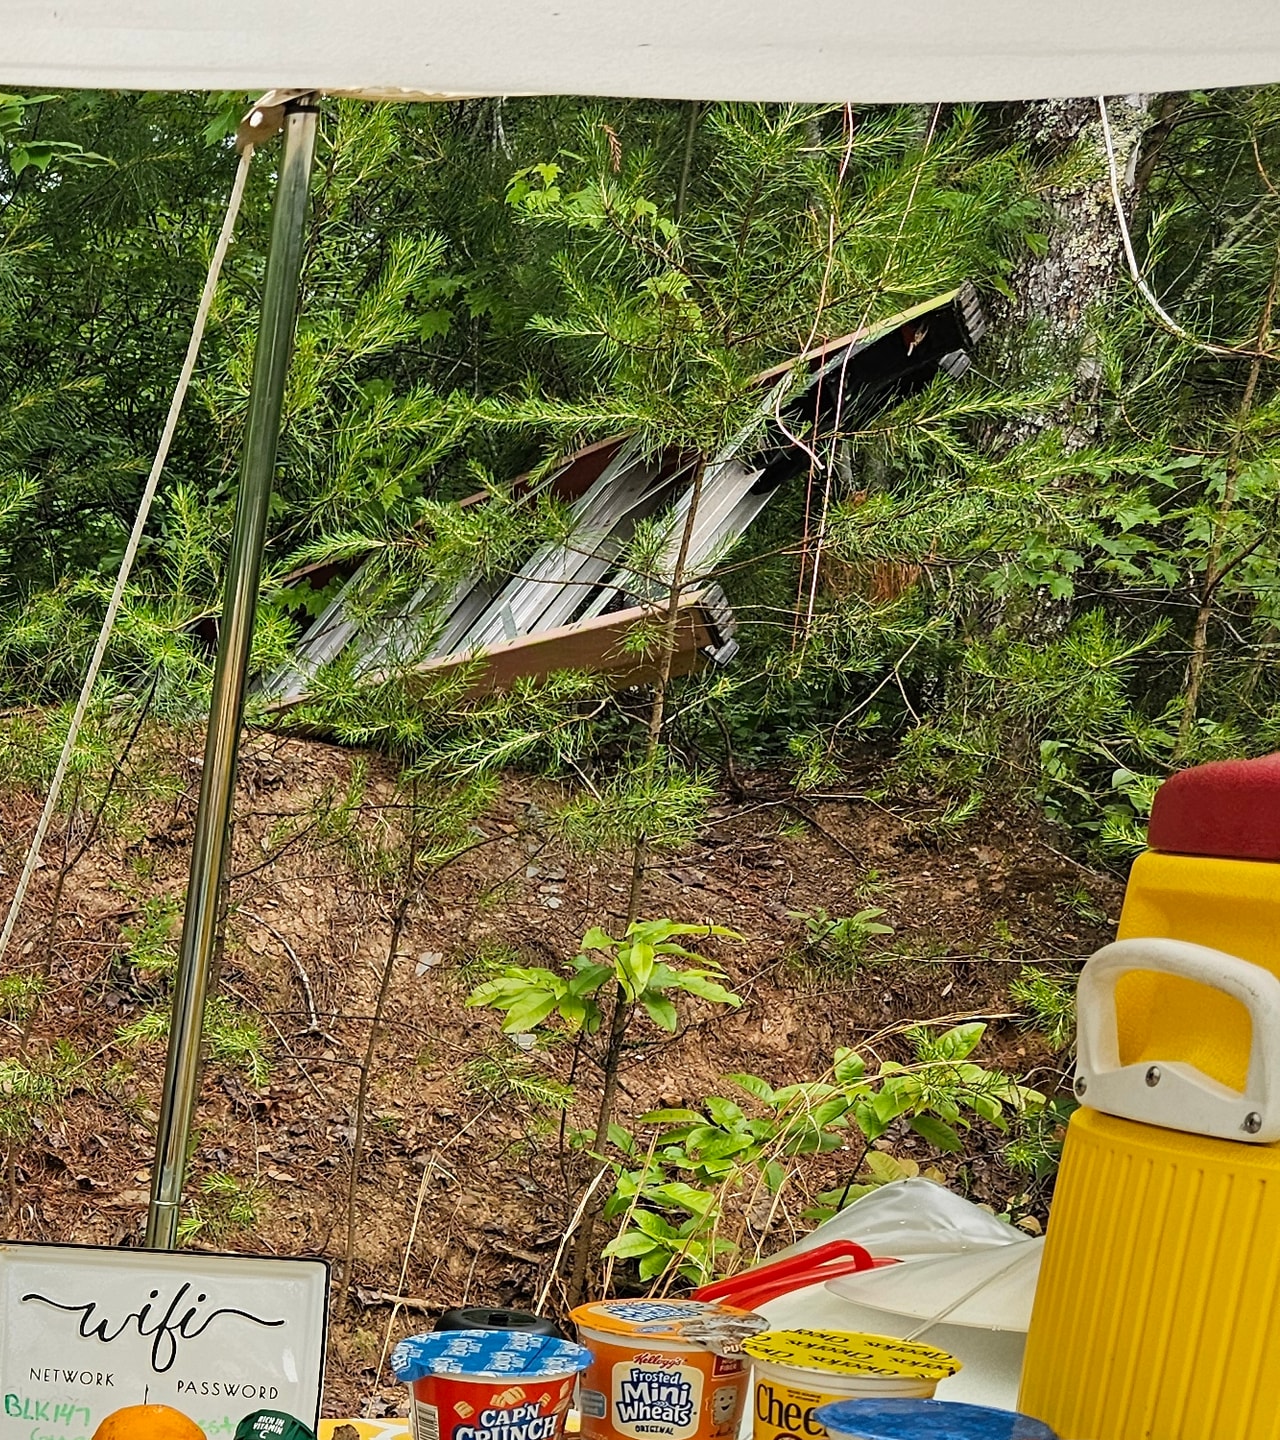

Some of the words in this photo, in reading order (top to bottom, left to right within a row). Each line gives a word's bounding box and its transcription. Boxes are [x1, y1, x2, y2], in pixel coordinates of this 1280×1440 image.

[22, 1282, 285, 1373] wifi
[633, 1352, 683, 1369] Kellogg's
[30, 1367, 115, 1387] NETWORK
[631, 1369, 680, 1384] Frosted
[177, 1380, 279, 1400] PASSWORD
[623, 1382, 691, 1406] Mini
[258, 1415, 275, 1425] RICH
[481, 1401, 541, 1427] CAP'N
[618, 1402, 692, 1426] Wheats
[252, 1423, 283, 1435] VITAMIN
[259, 1431, 267, 1440] C
[635, 1425, 674, 1435] ORIGINAL
